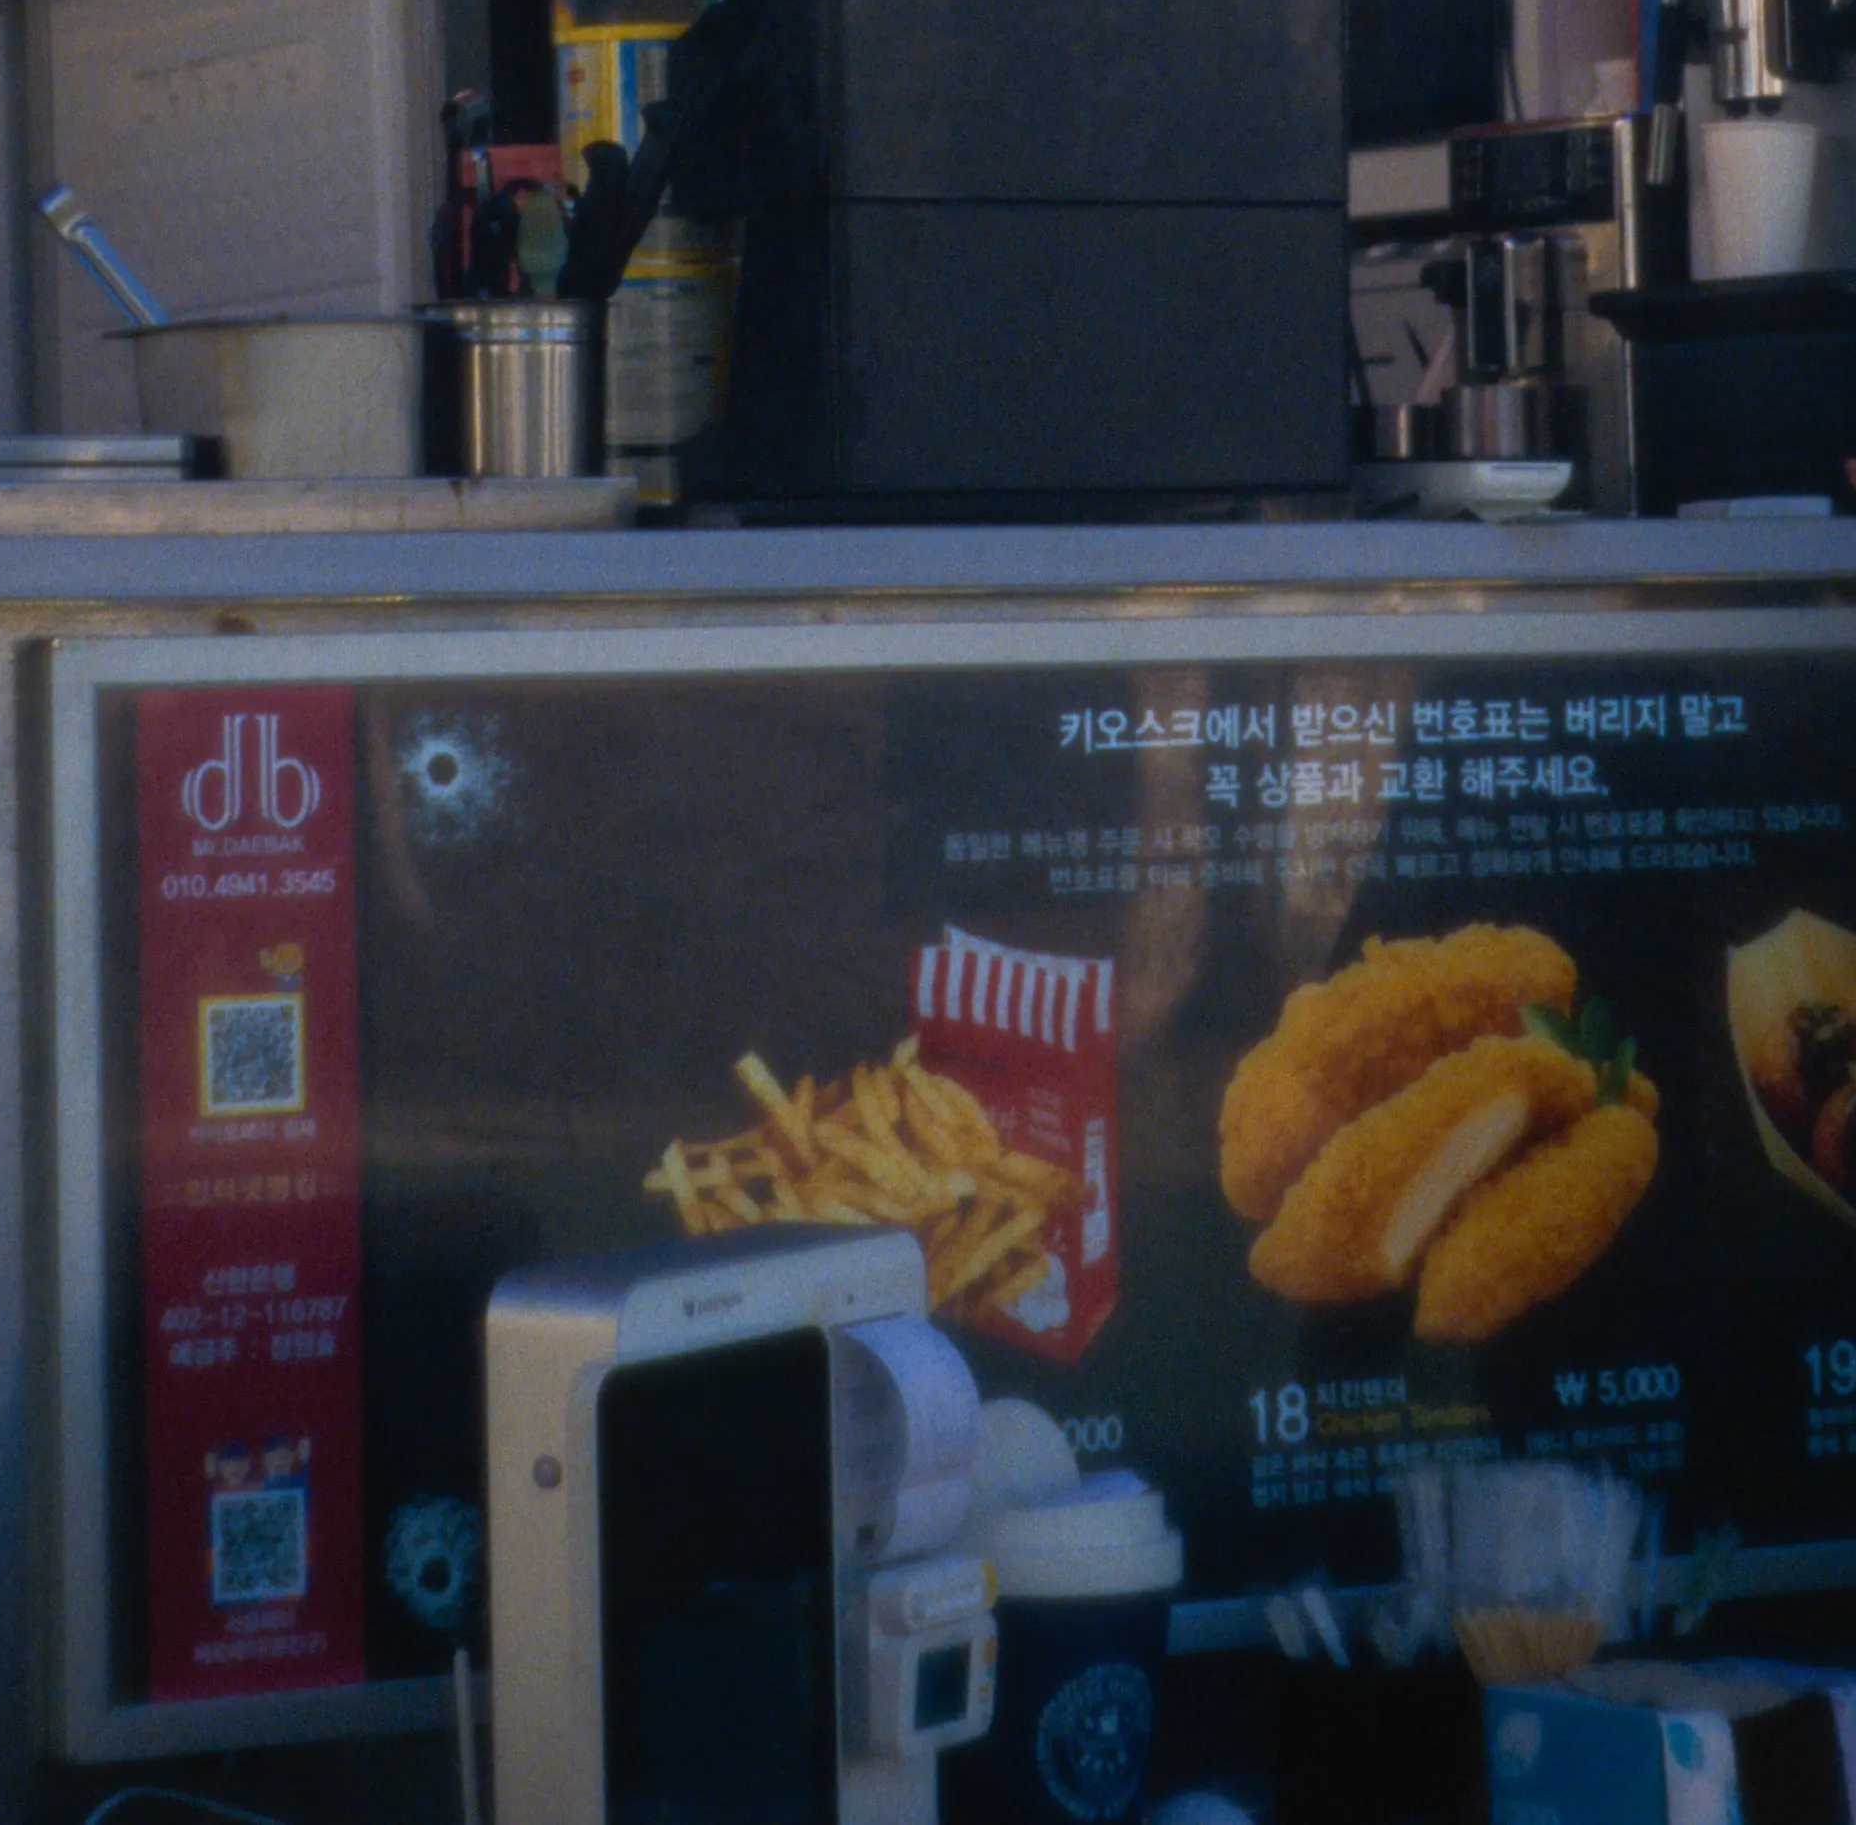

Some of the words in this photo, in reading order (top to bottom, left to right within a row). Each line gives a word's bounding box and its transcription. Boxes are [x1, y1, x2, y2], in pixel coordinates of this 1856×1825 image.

[1057, 706, 1277, 754] 키오스크에서
[1290, 701, 1397, 748] 받으신
[1410, 700, 1551, 745] 번호표는
[1565, 695, 1667, 740] 버리지
[1678, 692, 1747, 737] 말고
[1204, 762, 1241, 807] 꼭
[1255, 761, 1365, 805] 상품과
[1375, 758, 1447, 803] 교환
[1461, 754, 1610, 801] 해주세요.
[1247, 1381, 1311, 1446] 18
[1552, 1370, 1590, 1409] ₩
[1596, 1362, 1682, 1409] 5,000
